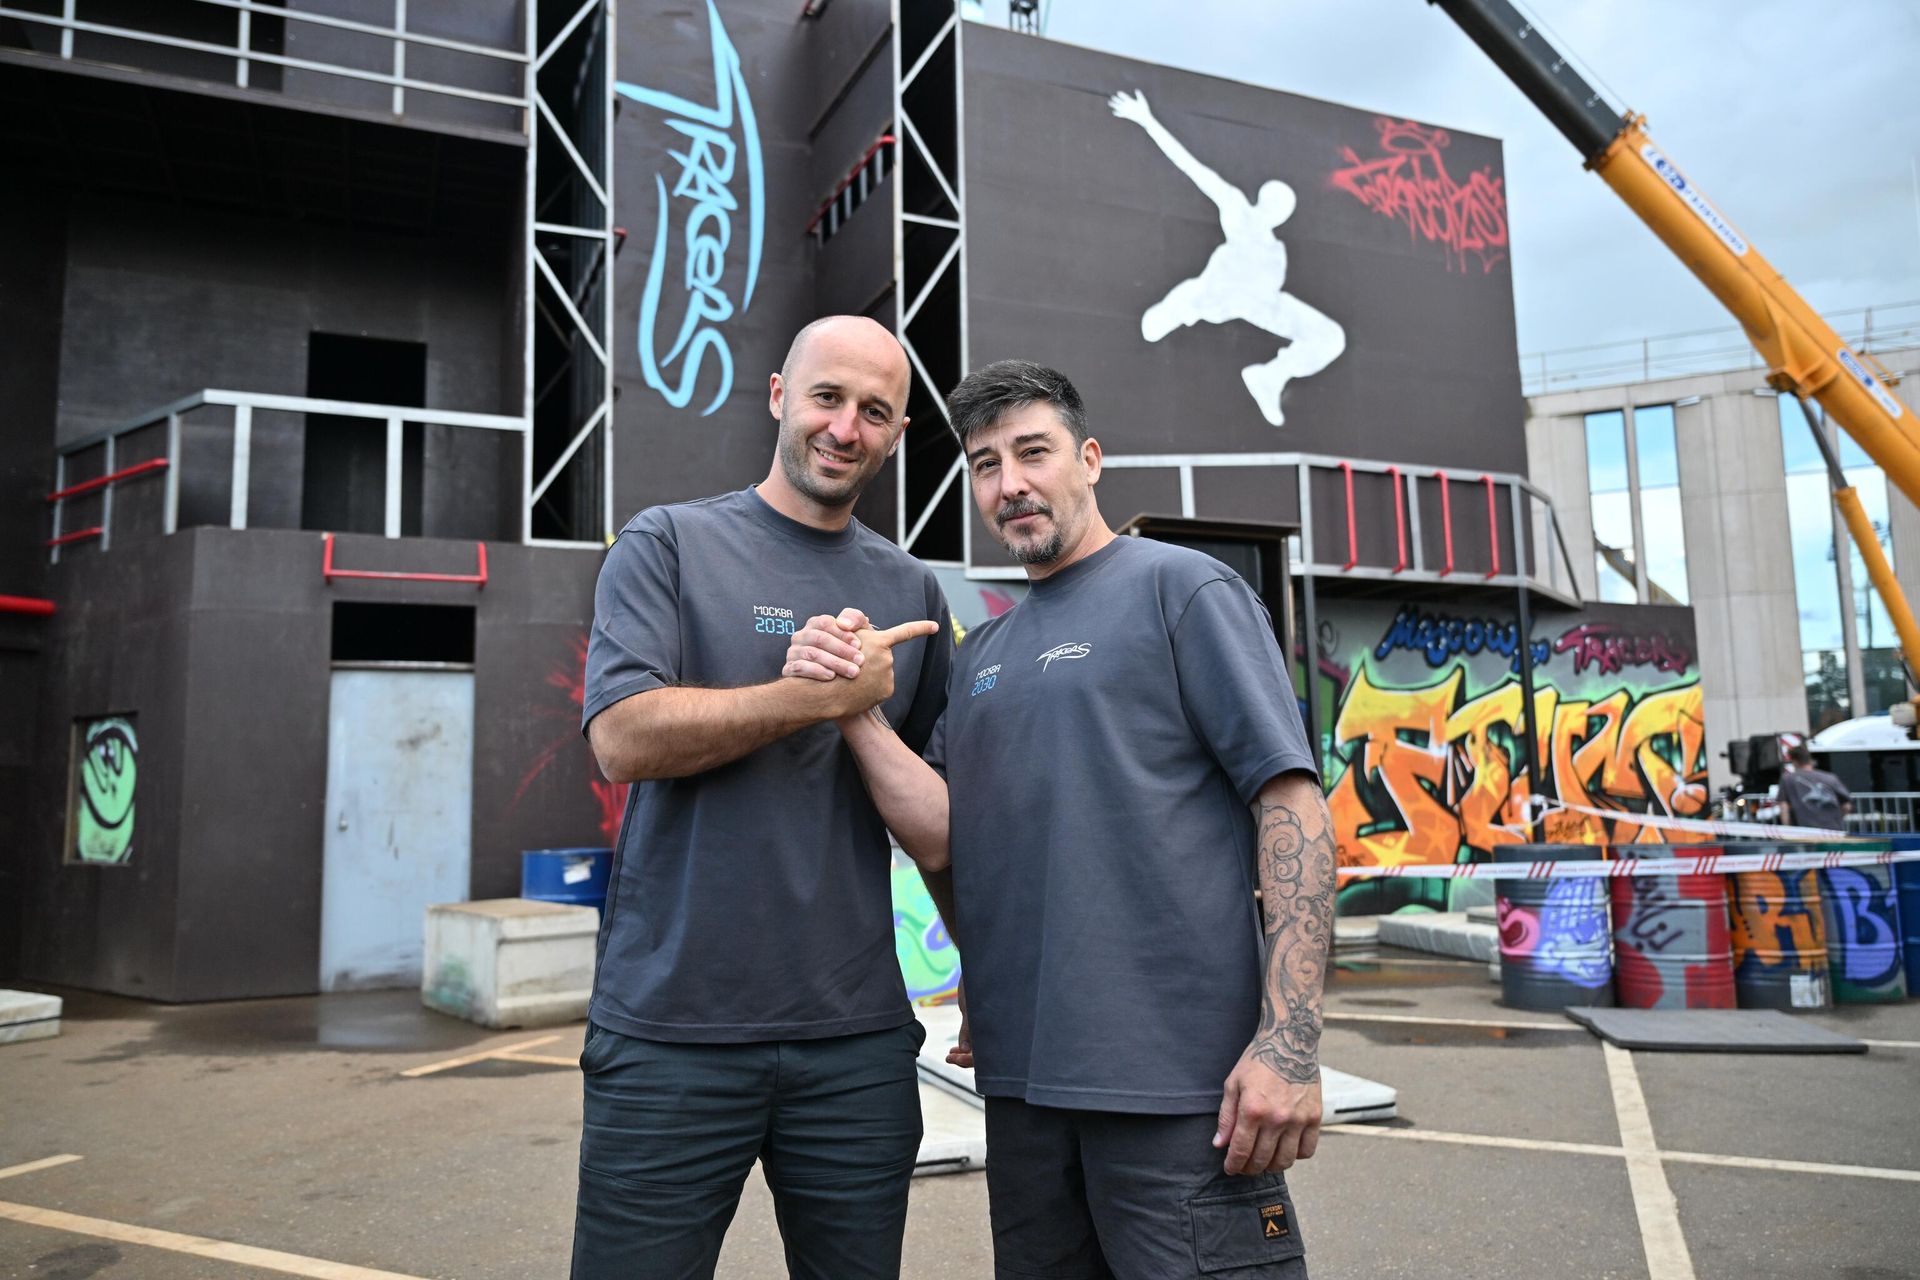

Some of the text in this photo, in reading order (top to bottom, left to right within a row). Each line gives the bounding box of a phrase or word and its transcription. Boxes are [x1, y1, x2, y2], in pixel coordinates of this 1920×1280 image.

[753, 605, 794, 619] МОСКВА
[755, 616, 796, 635] 2030
[976, 663, 1002, 681] МОСКВА
[971, 674, 997, 697] 2030
